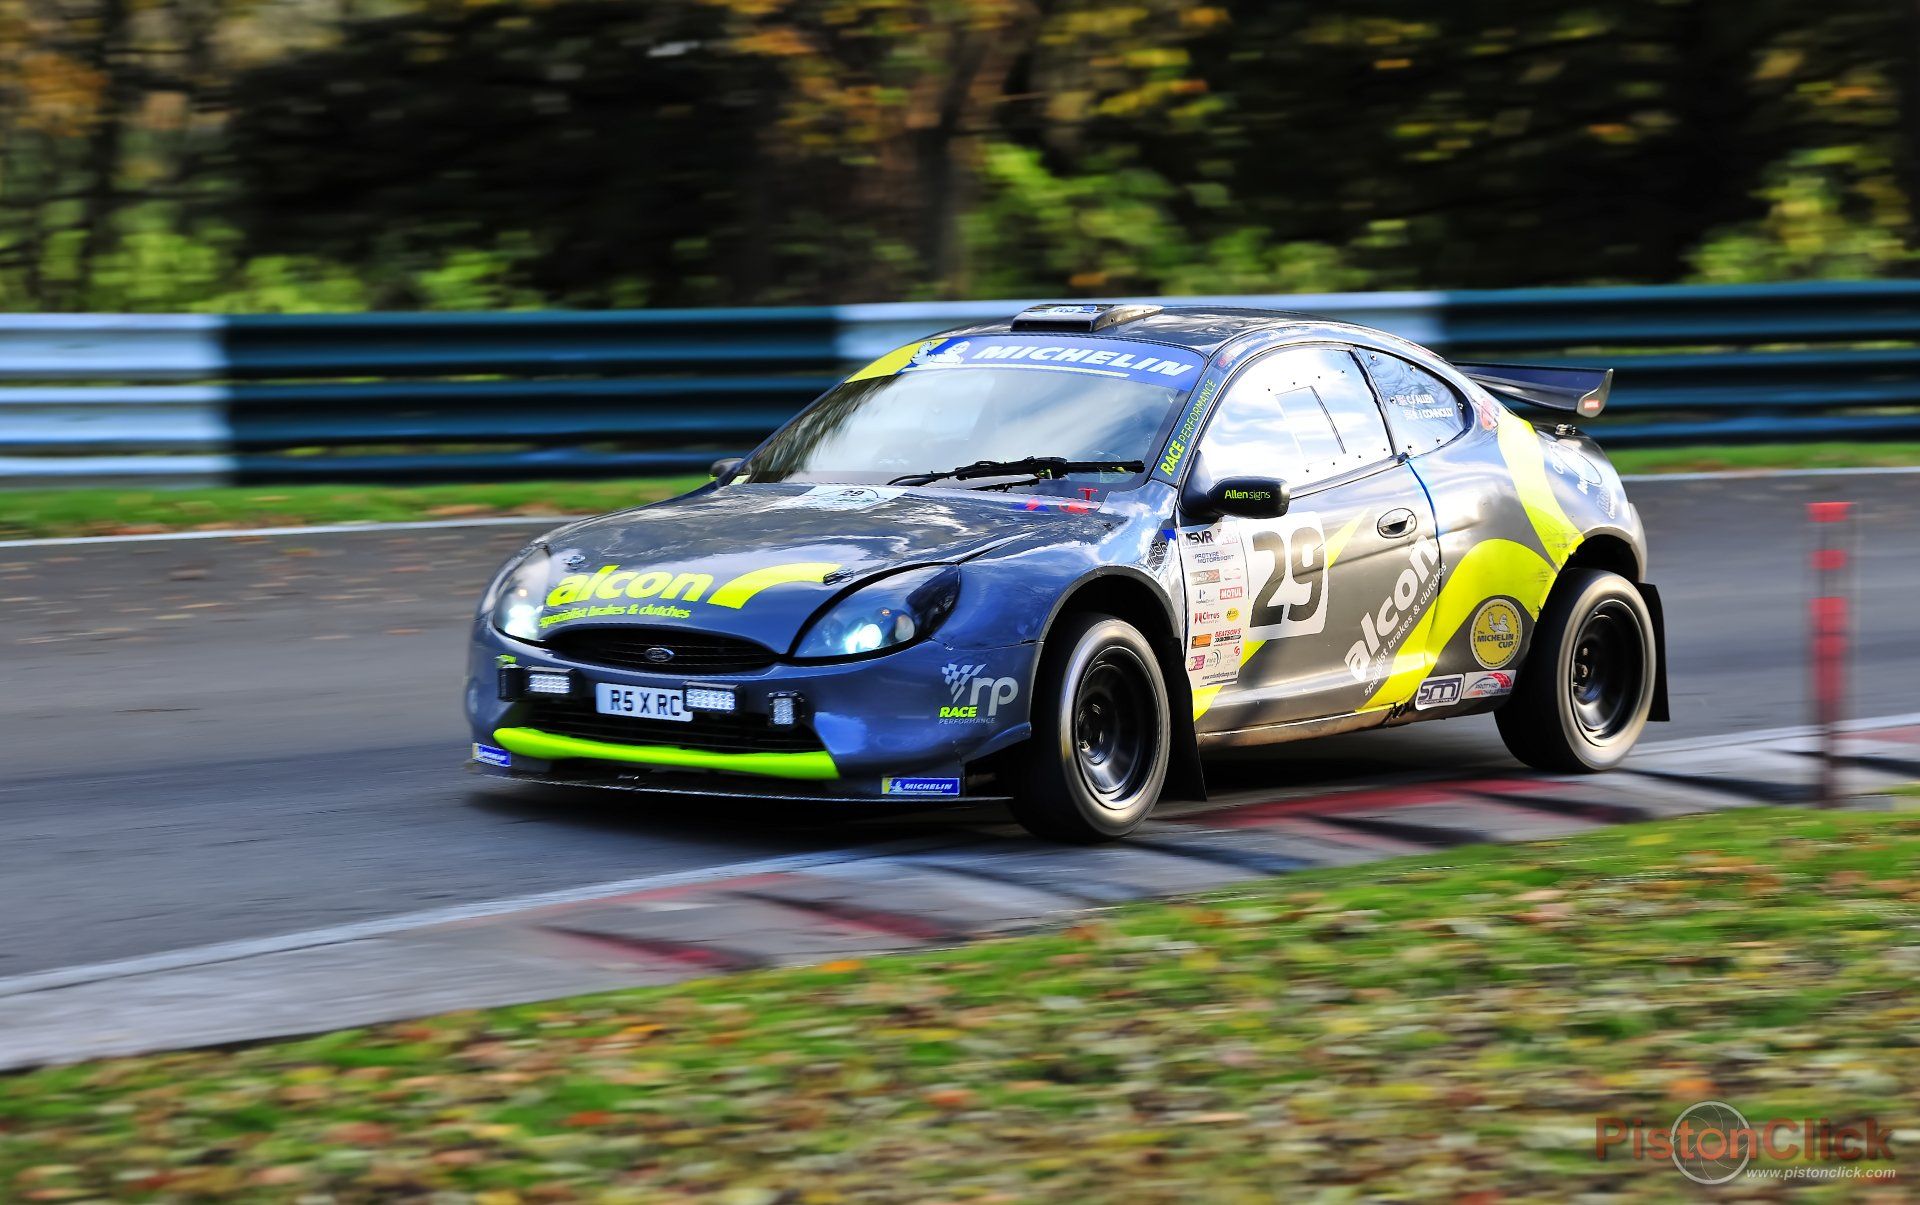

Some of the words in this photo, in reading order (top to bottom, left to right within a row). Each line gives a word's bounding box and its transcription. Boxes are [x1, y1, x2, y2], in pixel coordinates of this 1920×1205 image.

[972, 345, 1195, 377] MICHELIN
[1160, 439, 1186, 476] RACE
[1178, 379, 1217, 444] PERFORMANCE
[1224, 489, 1249, 499] Allen
[1249, 490, 1271, 501] signs
[1250, 527, 1325, 628] 29
[545, 564, 714, 608] alcon
[1221, 587, 1242, 599] MOTUL
[627, 604, 639, 615] &
[638, 603, 692, 619] clutches
[1344, 535, 1440, 682] alcon
[1364, 648, 1389, 697] specialist
[1387, 614, 1413, 649] brakes
[1412, 604, 1421, 614] &
[1420, 562, 1447, 606] clutches
[1477, 633, 1515, 643] MICHELIN
[1498, 641, 1514, 649] CUP
[610, 689, 634, 712] R5
[640, 692, 651, 714] X
[657, 693, 681, 716] RC
[939, 706, 978, 718] RACE
[938, 717, 996, 725] PERFORMANCE
[903, 782, 953, 790] MICHELIN
